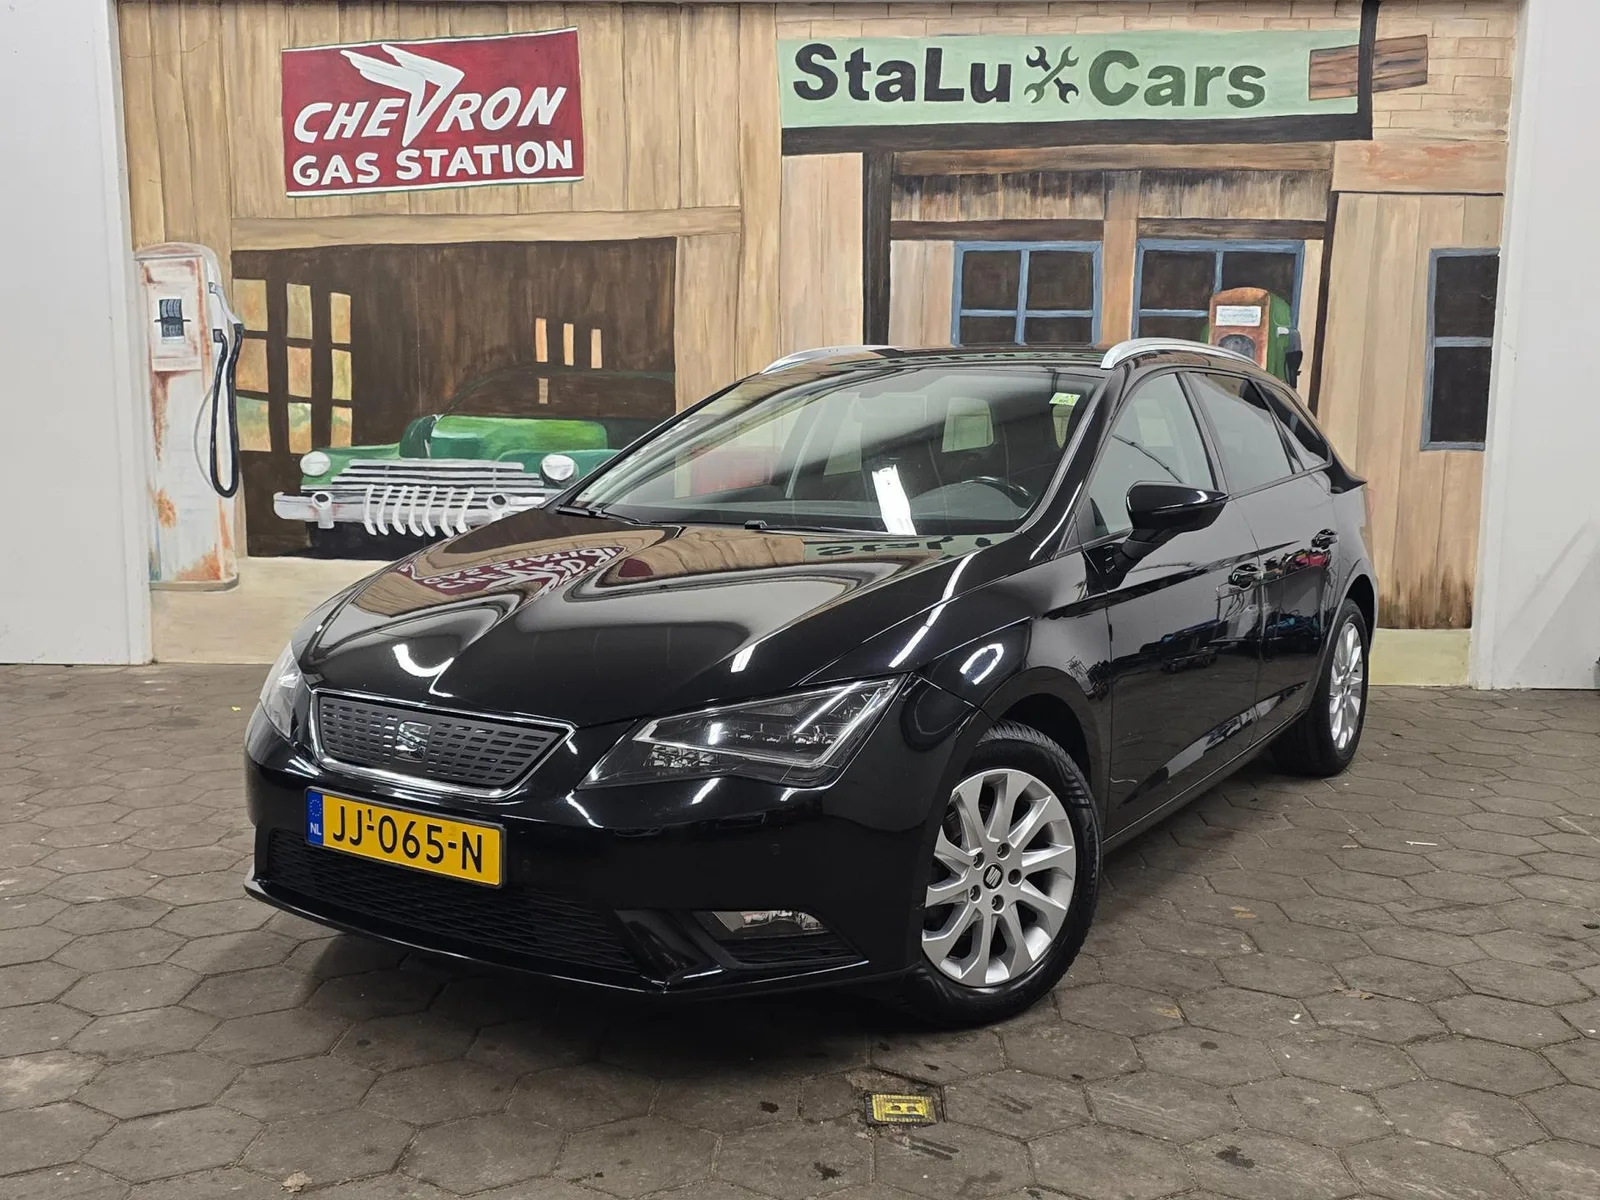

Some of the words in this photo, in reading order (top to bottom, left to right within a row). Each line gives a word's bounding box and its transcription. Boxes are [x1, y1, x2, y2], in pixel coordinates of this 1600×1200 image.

[293, 66, 567, 147] CHEVRON
[792, 43, 1012, 104] StaLu
[1088, 49, 1267, 108] Cars
[292, 152, 381, 186] GAS
[396, 140, 573, 181] STATION
[310, 822, 322, 836] NL
[333, 805, 483, 873] JJ-065-N
